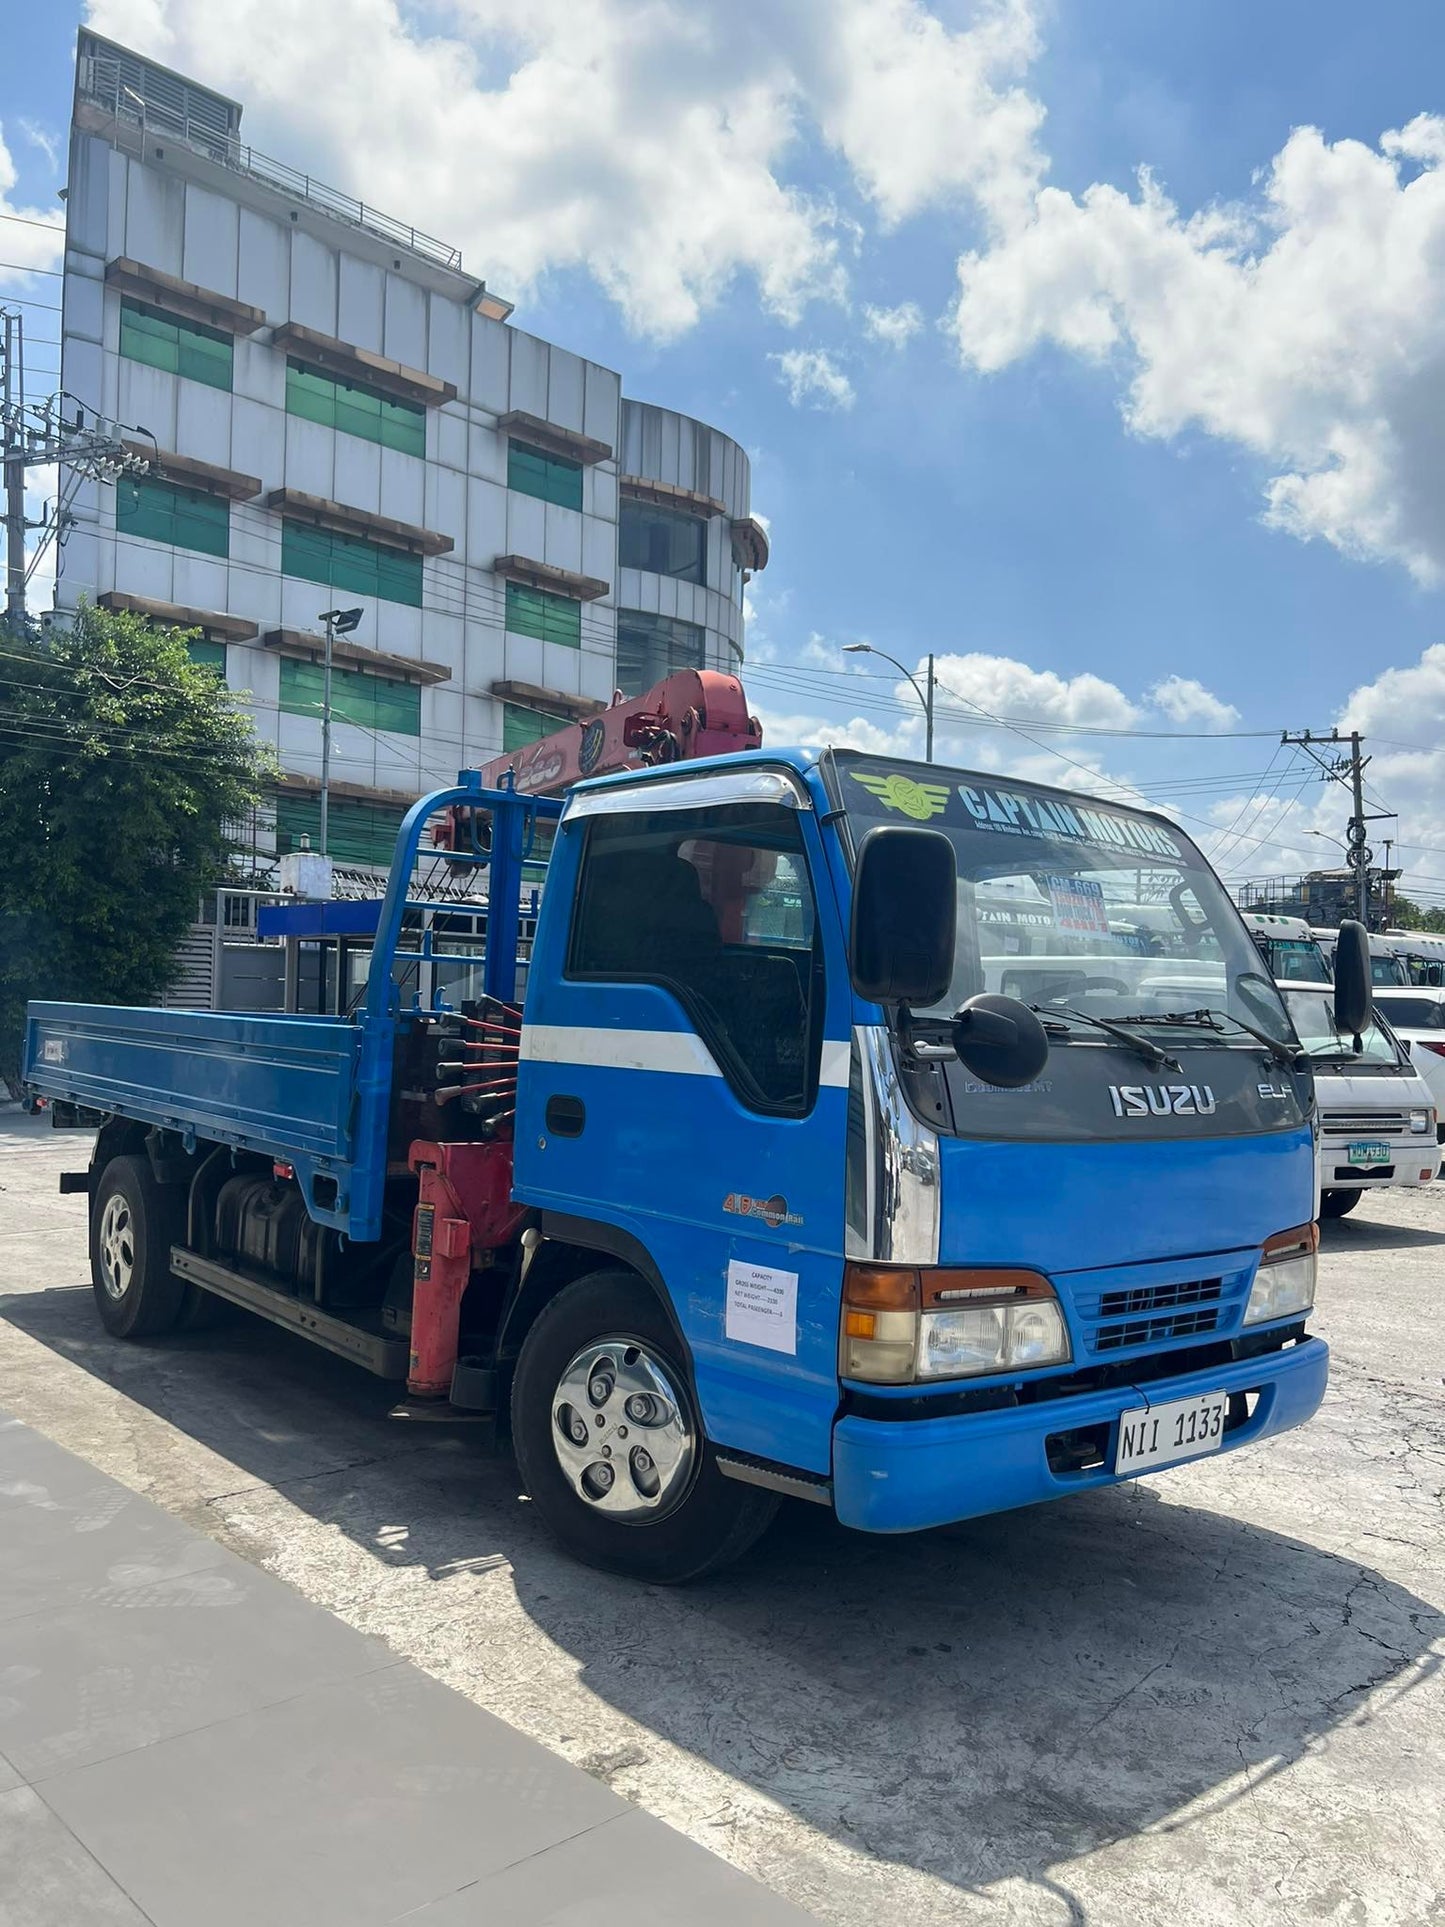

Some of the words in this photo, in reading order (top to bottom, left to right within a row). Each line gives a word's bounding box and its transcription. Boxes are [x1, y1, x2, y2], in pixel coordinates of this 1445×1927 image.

[957, 784, 1086, 838] CAPTAIN
[1075, 806, 1182, 858] MOTORS
[1050, 876, 1100, 897] CM-669
[1016, 912, 1053, 926] MOTO
[1108, 1085, 1216, 1117] ISUZU
[1257, 1083, 1293, 1099] ELF
[1122, 1419, 1159, 1459] NII
[1173, 1405, 1222, 1446] 1133
